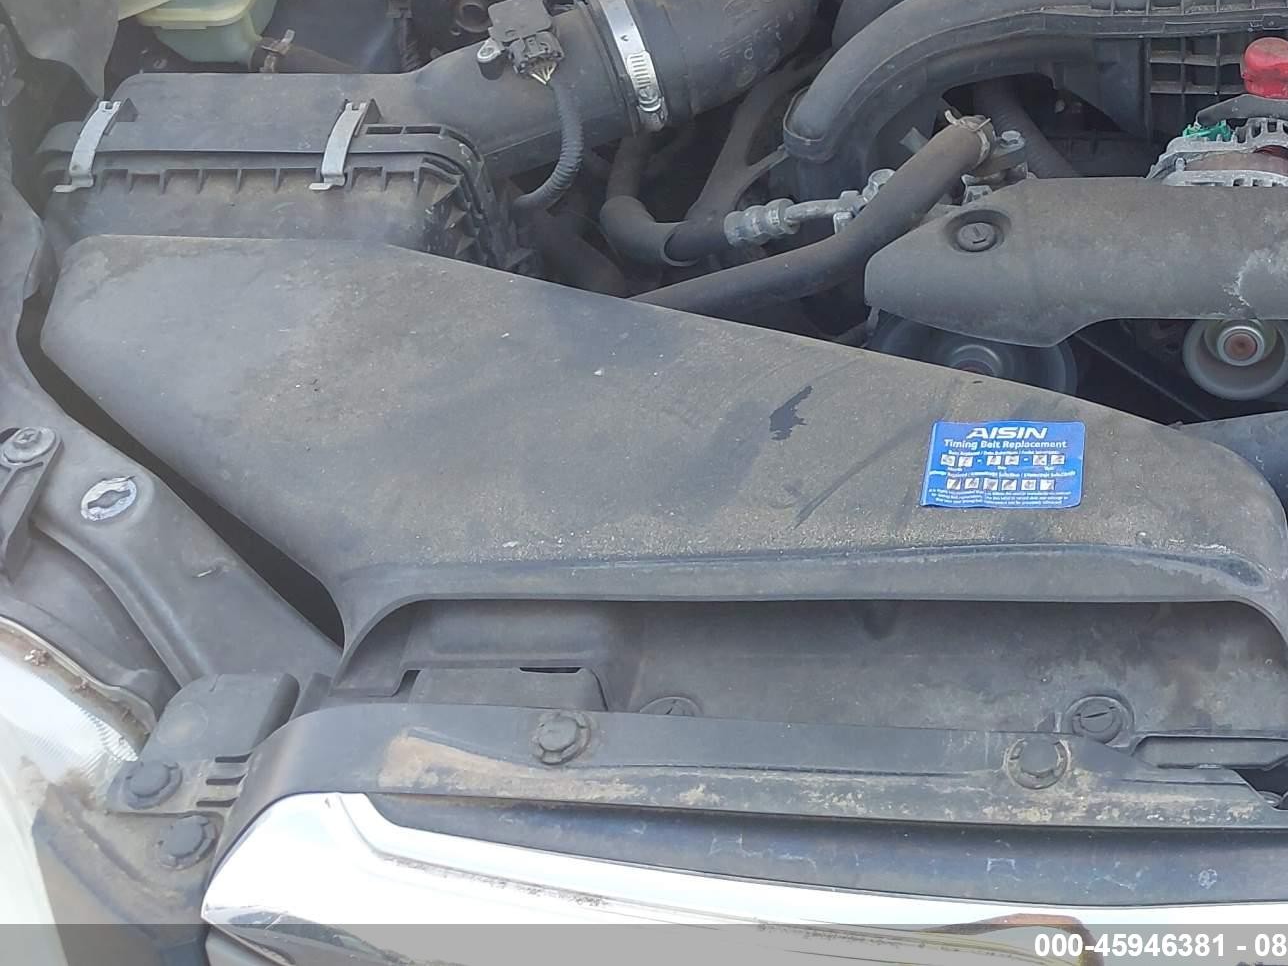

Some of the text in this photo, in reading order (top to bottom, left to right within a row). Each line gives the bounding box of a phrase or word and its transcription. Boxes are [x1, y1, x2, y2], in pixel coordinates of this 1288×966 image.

[966, 426, 1048, 439] AISIN
[944, 440, 1067, 450] Timing Belt Replacement
